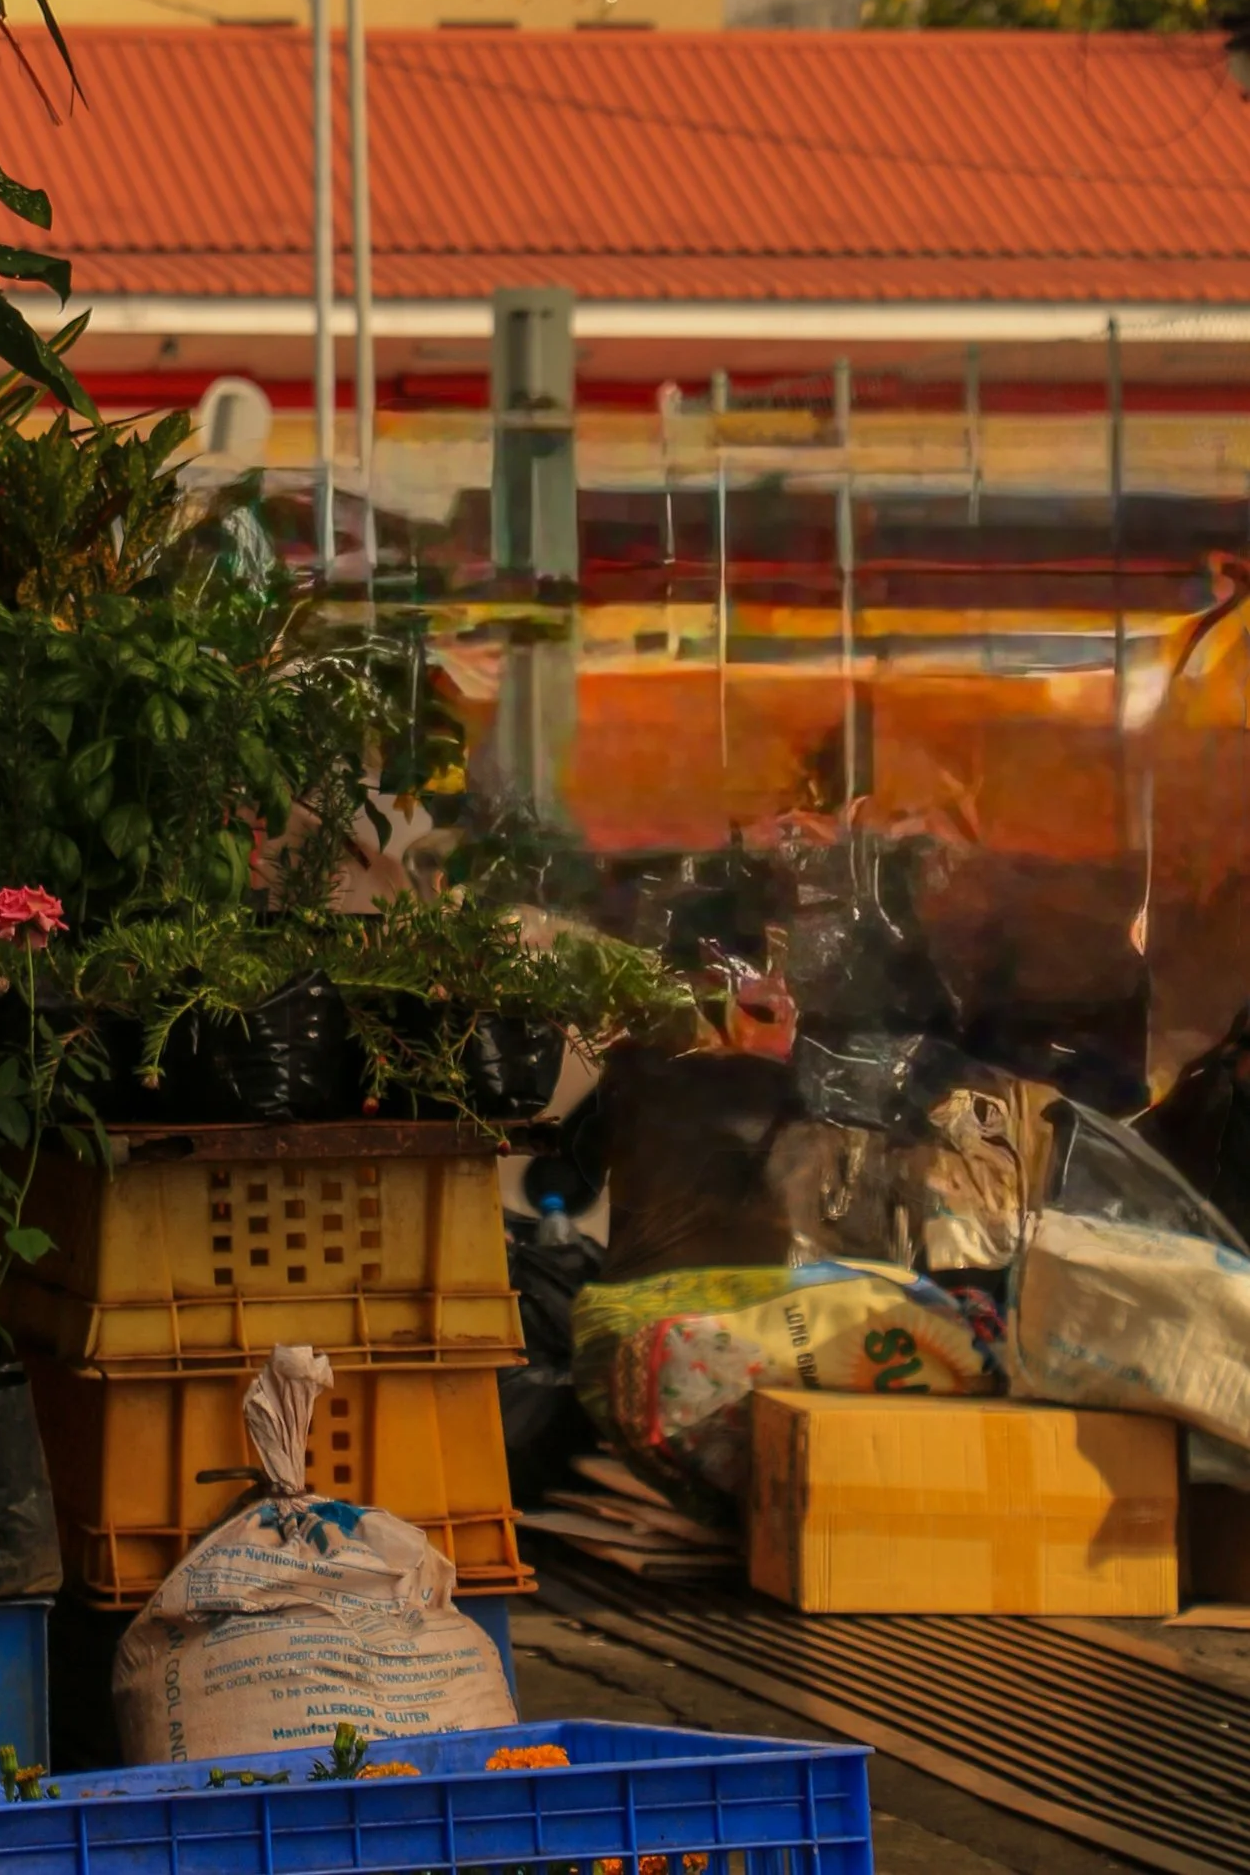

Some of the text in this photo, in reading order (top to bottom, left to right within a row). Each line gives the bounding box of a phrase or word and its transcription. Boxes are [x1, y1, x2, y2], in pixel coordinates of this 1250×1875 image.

[245, 1546, 308, 1570] Nutritional
[258, 1668, 286, 1683] FOLIC
[165, 1659, 180, 1716] COOL
[271, 1688, 284, 1701] To
[286, 1686, 302, 1697] be
[304, 1683, 346, 1696] cooked
[306, 1704, 375, 1718] ALLERGEN
[384, 1711, 431, 1724] GLUTEN
